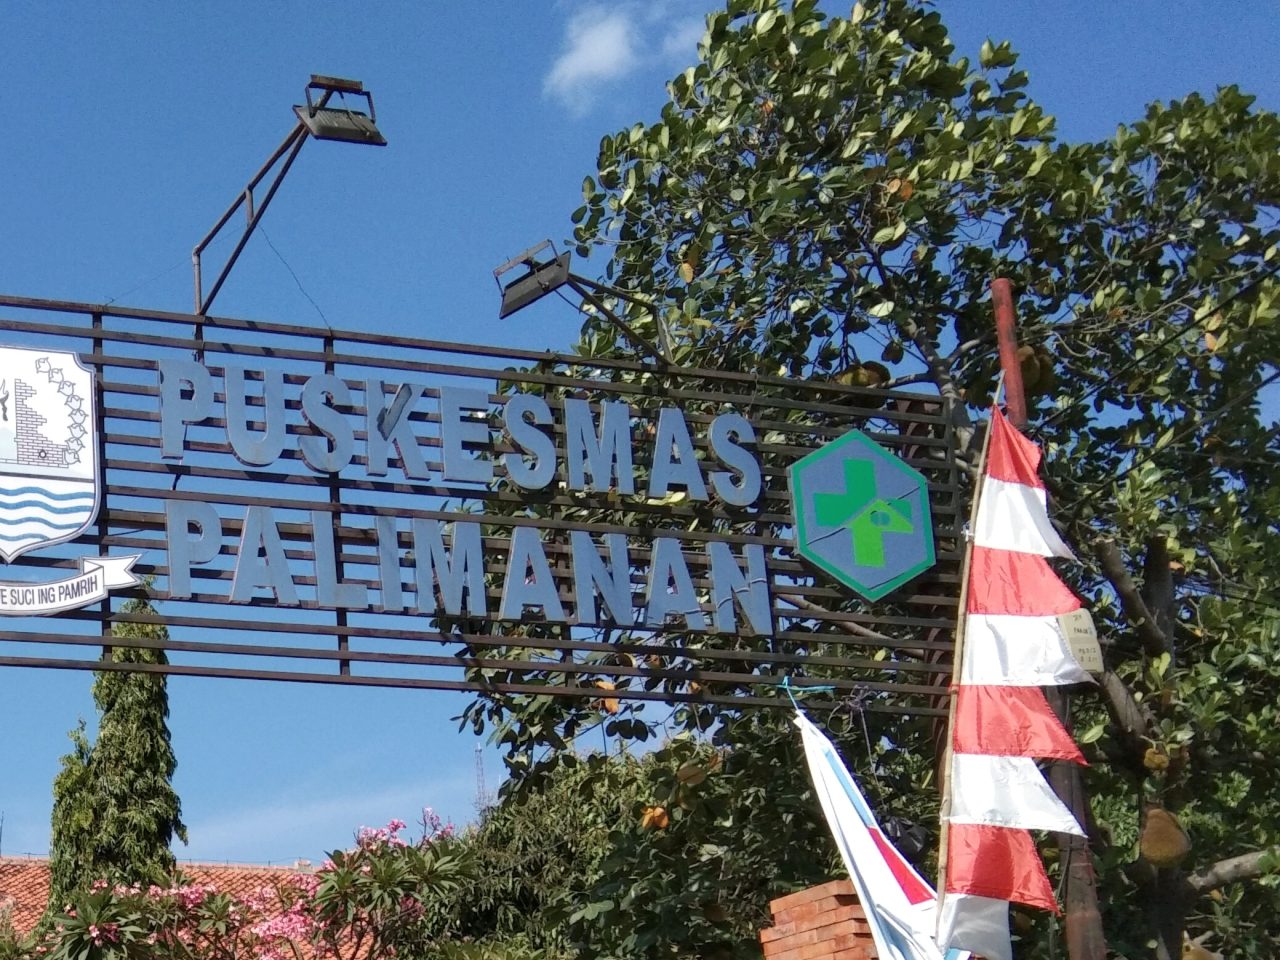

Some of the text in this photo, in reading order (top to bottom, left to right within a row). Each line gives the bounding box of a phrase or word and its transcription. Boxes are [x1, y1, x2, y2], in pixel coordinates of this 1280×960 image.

[158, 359, 762, 508] PUSKESMAS
[10, 588, 35, 606] SUCI
[38, 587, 55, 604] ING
[58, 575, 98, 601] PAMRIH
[164, 499, 773, 637] PALIMANAN
